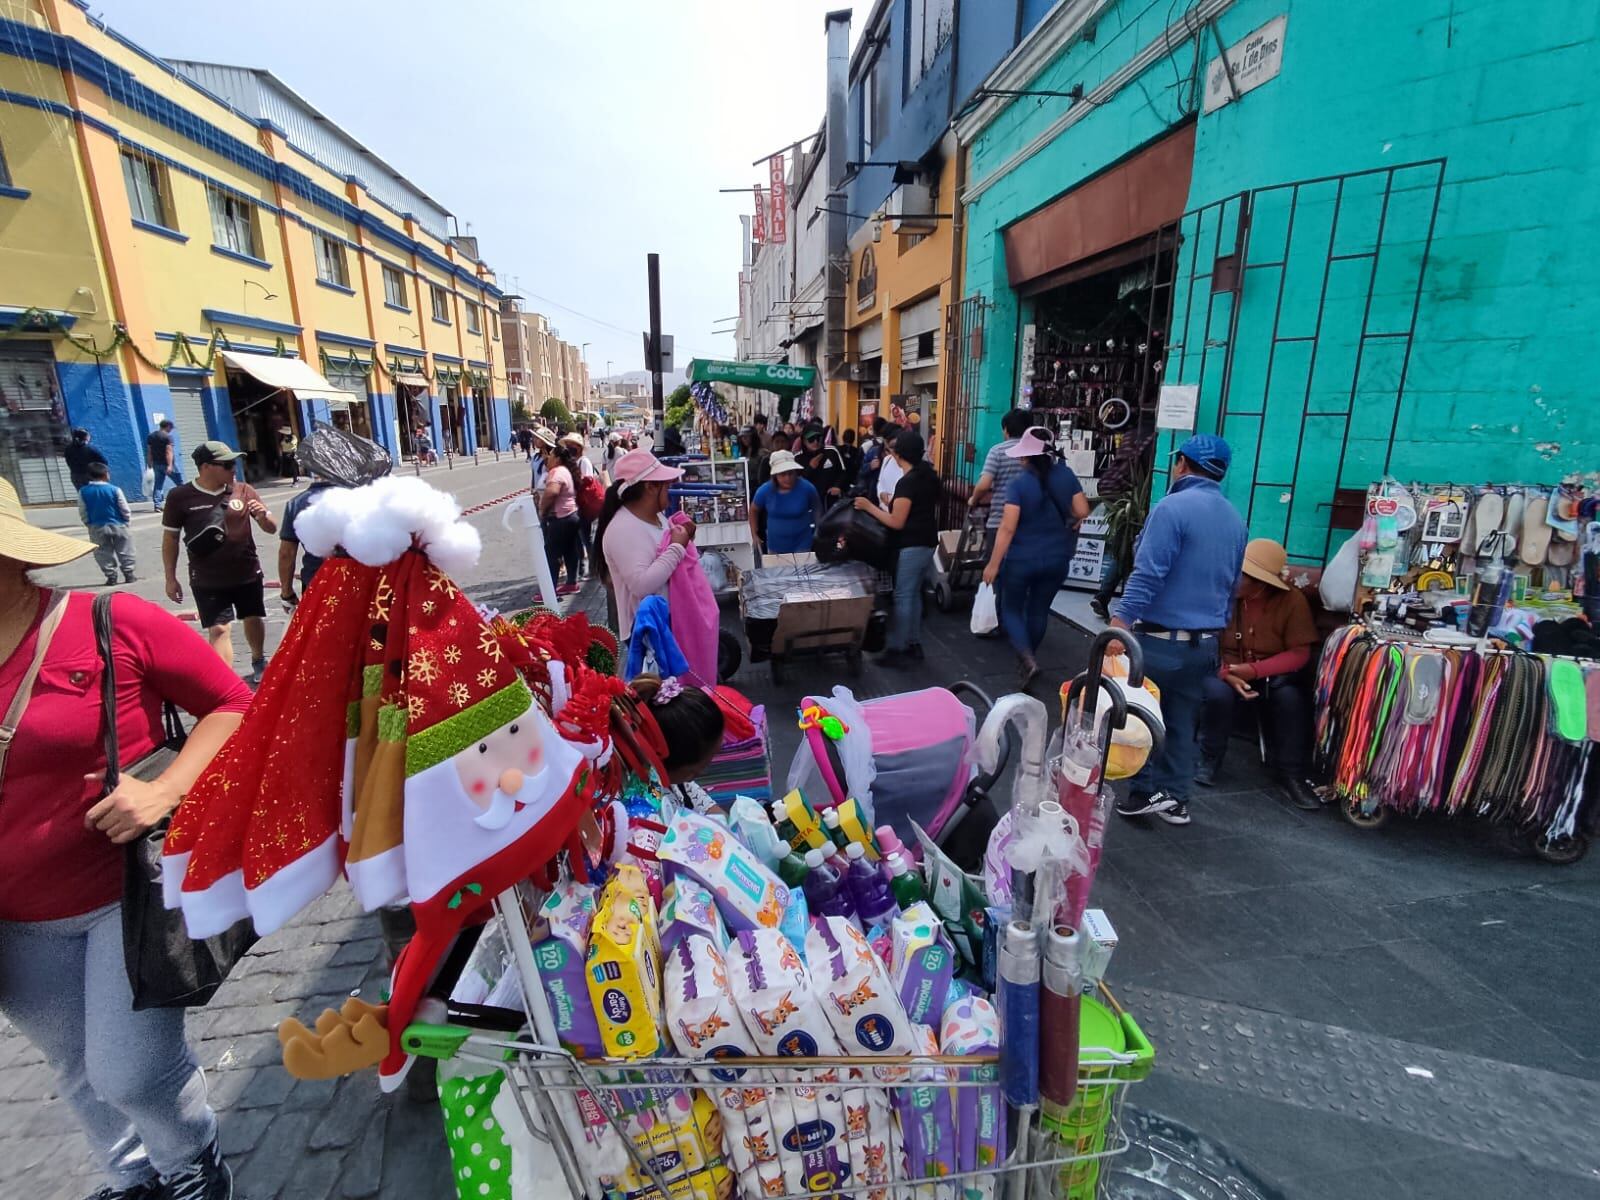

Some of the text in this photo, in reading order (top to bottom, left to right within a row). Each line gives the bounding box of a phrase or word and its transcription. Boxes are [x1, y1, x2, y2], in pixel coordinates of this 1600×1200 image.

[1248, 50, 1259, 68] de
[1260, 38, 1278, 60] Dios
[771, 158, 783, 234] HOSTAL
[766, 366, 804, 380] COOL
[541, 944, 559, 969] 120
[926, 949, 941, 971] 120
[548, 978, 573, 1031] DINOSAURIOS
[608, 992, 622, 1019] Gardy
[910, 979, 932, 1022] DINOSAURIO
[623, 1031, 633, 1045] 100
